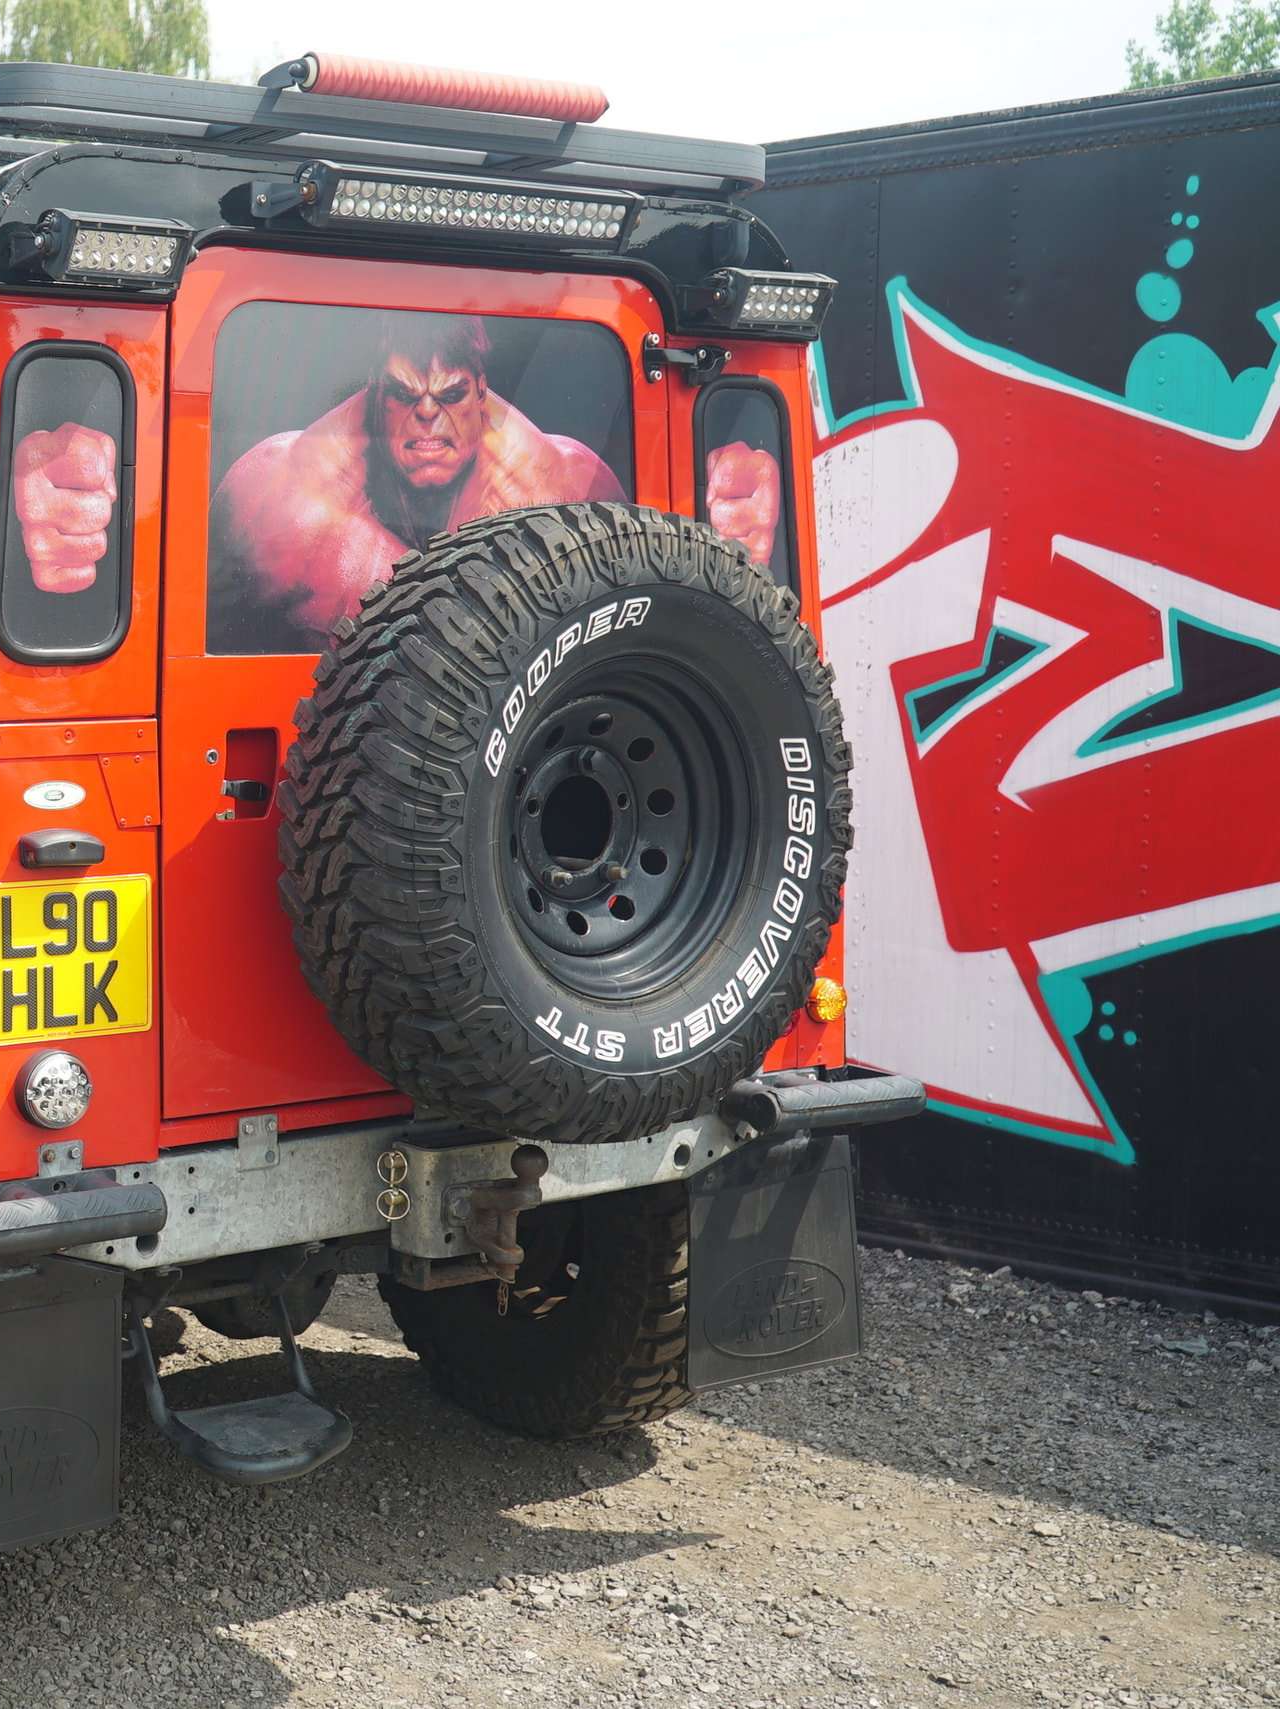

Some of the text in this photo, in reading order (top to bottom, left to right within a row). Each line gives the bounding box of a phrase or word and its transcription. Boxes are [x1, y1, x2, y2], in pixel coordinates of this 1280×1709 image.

[485, 596, 651, 777] COOPER
[1, 889, 119, 960] L90
[535, 737, 816, 1062] DISCOVERER STT
[1, 959, 119, 1033] HLK
